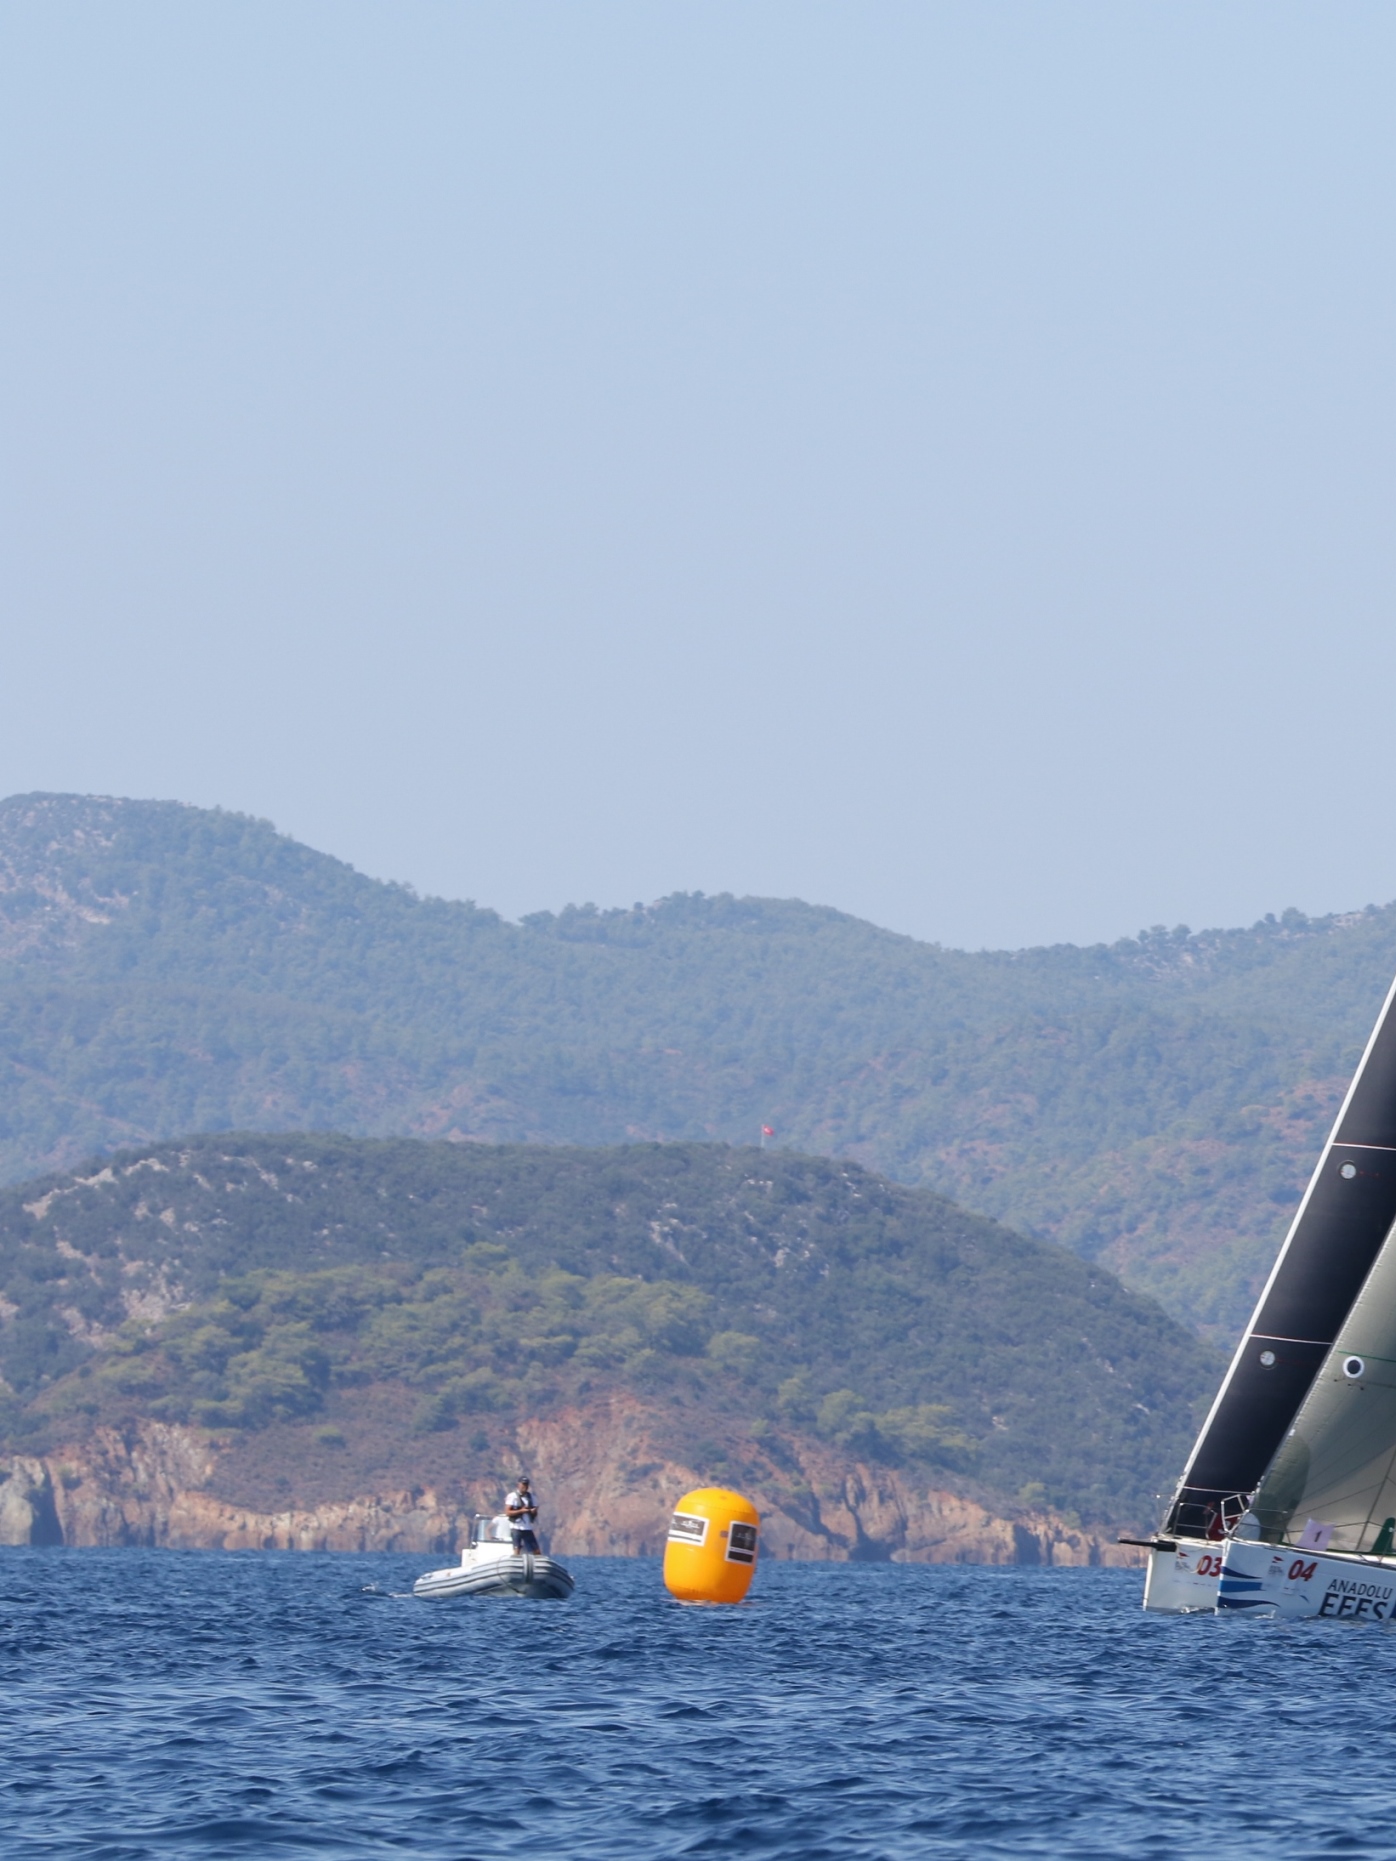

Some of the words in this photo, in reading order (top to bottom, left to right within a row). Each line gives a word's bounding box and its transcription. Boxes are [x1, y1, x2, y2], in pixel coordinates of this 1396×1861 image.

[1314, 1530, 1322, 1543] 1
[1196, 1555, 1222, 1577] 03
[1288, 1559, 1318, 1582] 04
[1327, 1579, 1394, 1600] ANADOLU
